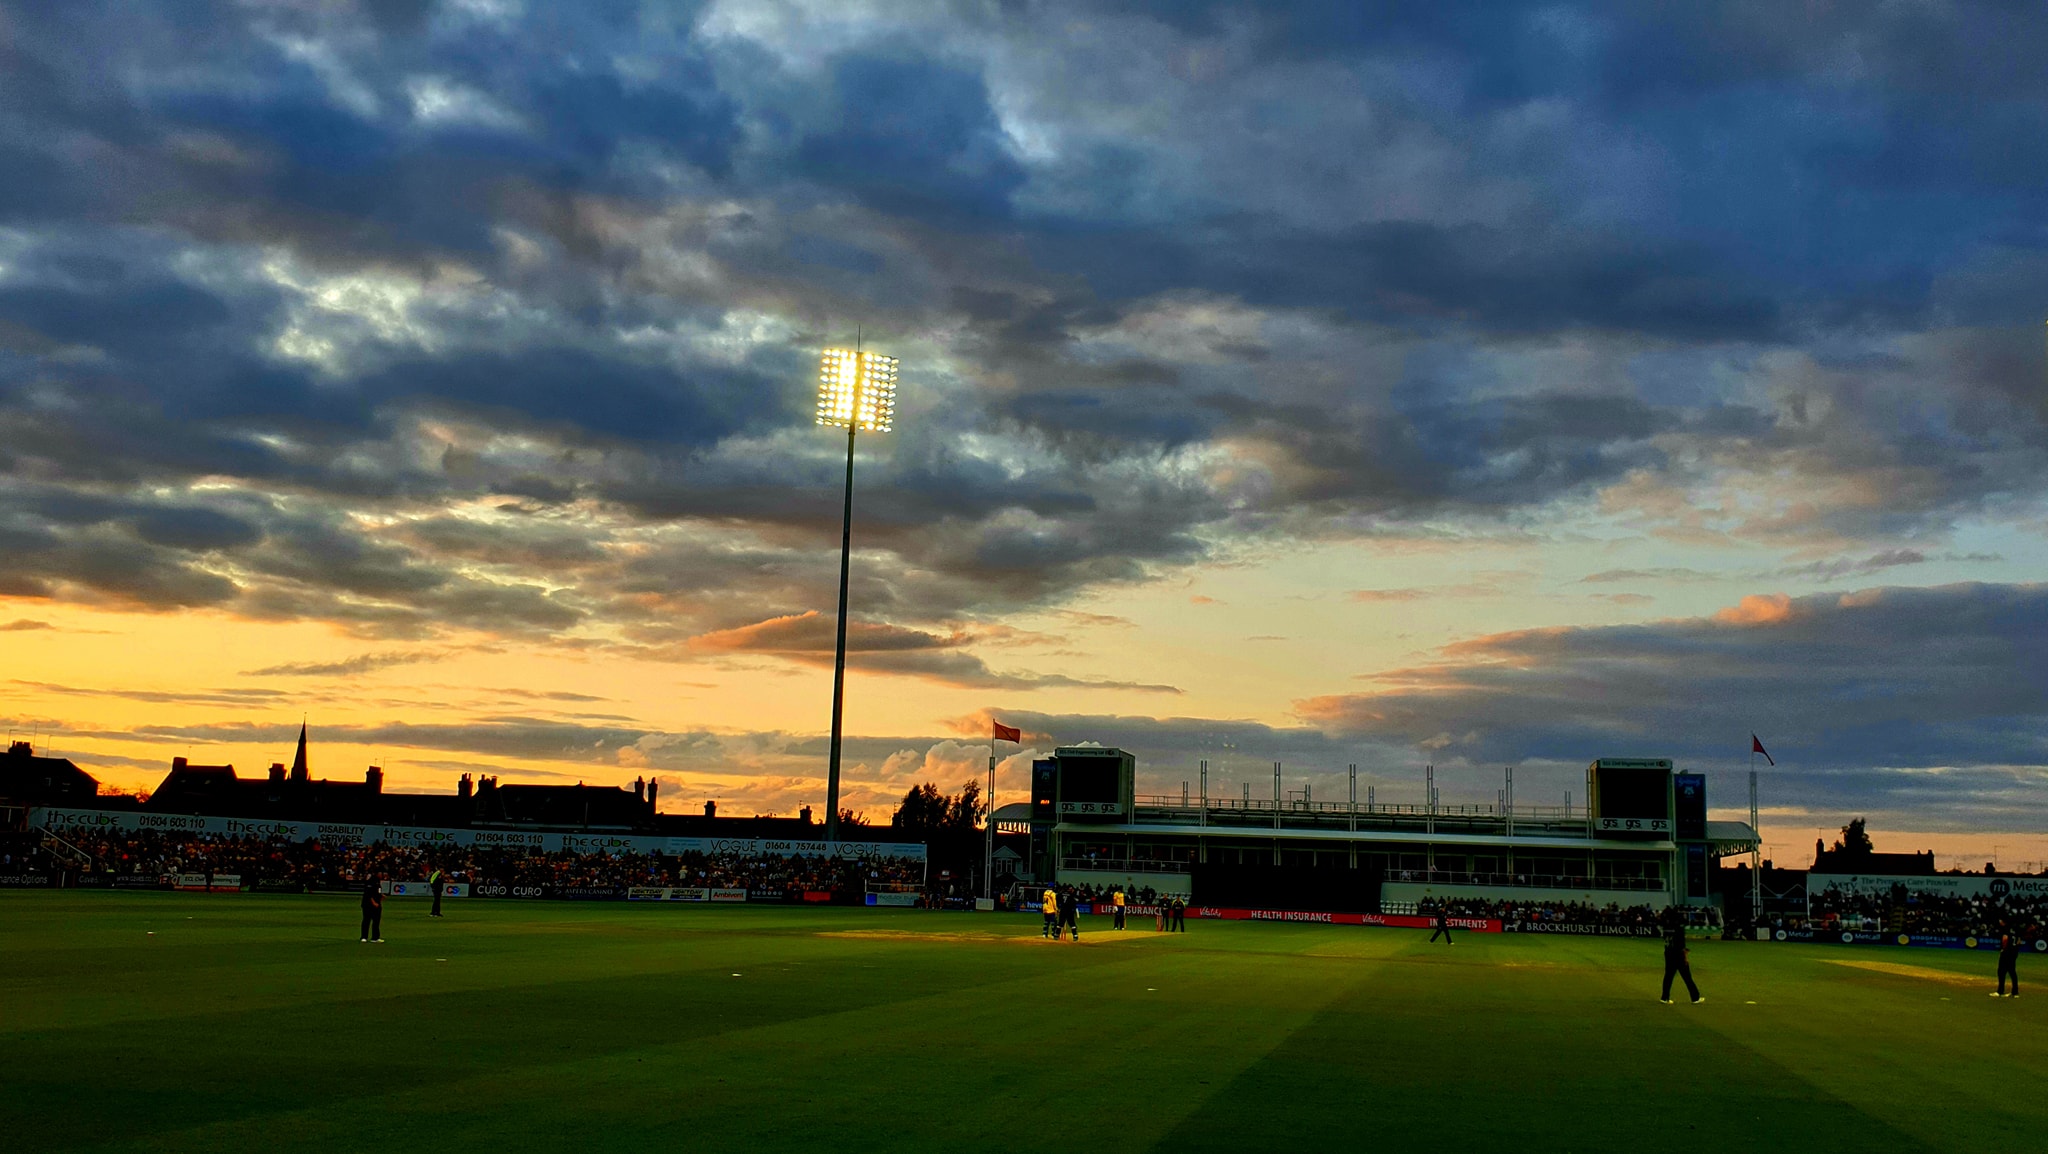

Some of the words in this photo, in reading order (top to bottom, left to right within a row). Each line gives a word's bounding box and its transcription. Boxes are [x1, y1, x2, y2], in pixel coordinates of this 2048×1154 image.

[48, 811, 75, 823] the
[78, 812, 119, 826] cube
[139, 816, 168, 826] 01604
[170, 817, 186, 827] 603
[189, 818, 205, 829] 110
[227, 820, 254, 832] the
[257, 822, 298, 835] cube
[318, 825, 365, 835] DISABILITY
[320, 834, 362, 844] SERVICES
[384, 828, 410, 840] the
[413, 830, 455, 842] cube
[475, 832, 504, 842] 01604
[507, 834, 524, 843] 603
[528, 835, 543, 844] 110
[563, 835, 588, 847] the
[591, 837, 631, 848] cube
[711, 839, 757, 852] VOGUE
[765, 842, 791, 850] 01604
[834, 844, 881, 855] VOGUE
[477, 885, 507, 896] CURO
[512, 886, 542, 897] CURO
[1251, 910, 1282, 920] HEALTH
[1284, 912, 1332, 923] INSURANCE
[1429, 918, 1487, 929] INESTMENTS
[1526, 922, 1596, 934] BROCKHURST
